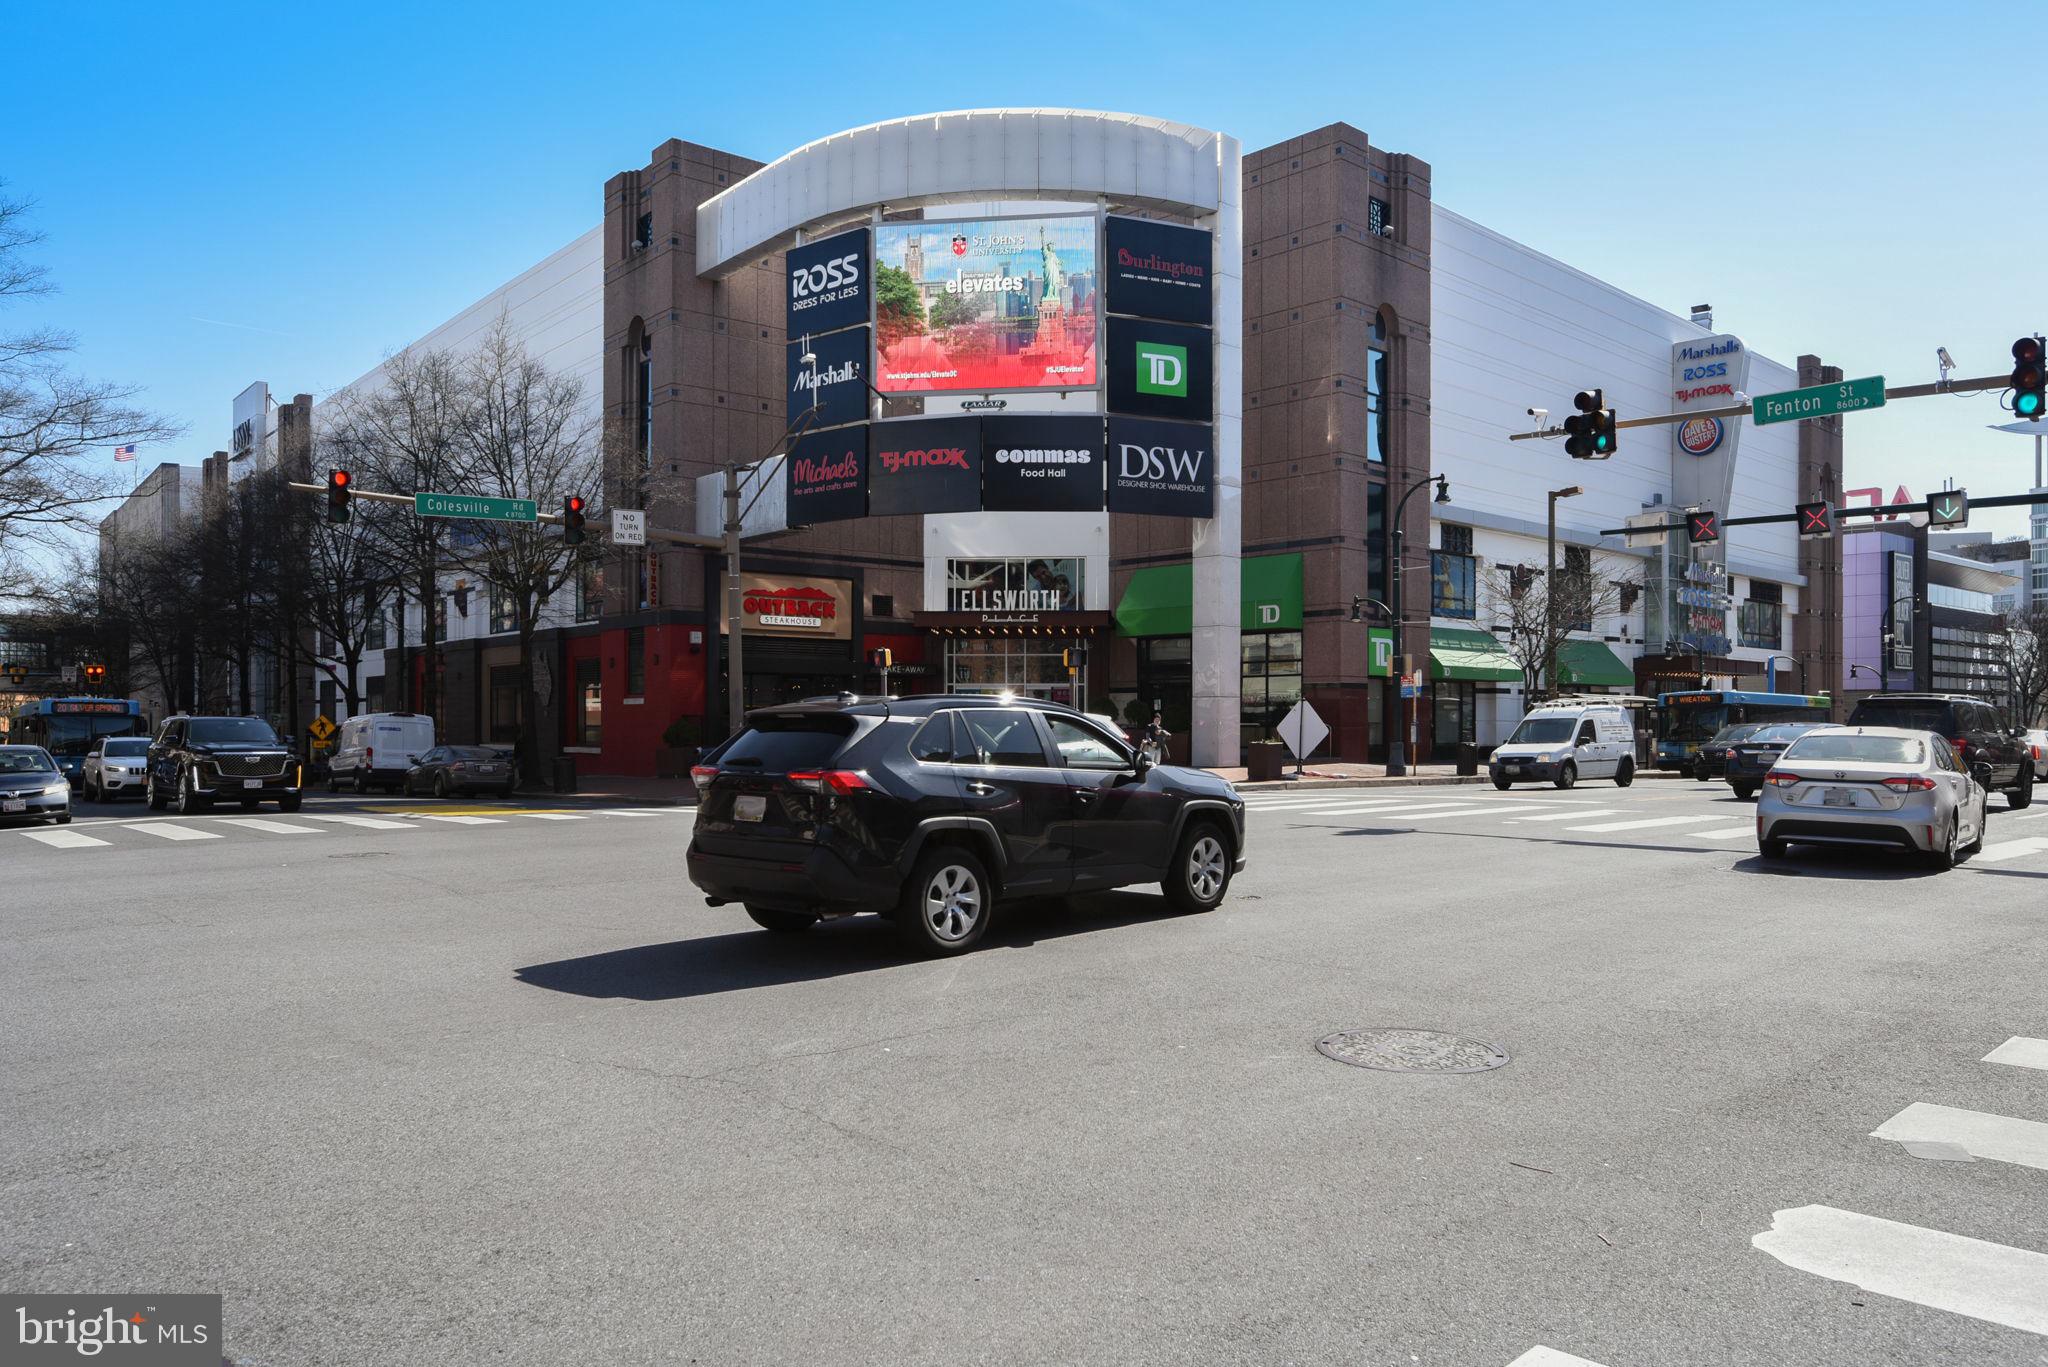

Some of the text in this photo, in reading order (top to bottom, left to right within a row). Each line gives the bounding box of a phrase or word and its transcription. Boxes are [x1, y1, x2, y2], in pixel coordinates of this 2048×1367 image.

[1117, 247, 1204, 278] Burlington
[793, 253, 859, 298] ROSS
[945, 268, 1024, 293] elevates
[793, 286, 859, 311] DRESS FOR LESS
[1676, 340, 1739, 362] Marshalls
[1141, 352, 1182, 386] TD
[1683, 362, 1728, 381] ROSS
[1766, 384, 1854, 417] Fenton St
[1836, 399, 1860, 409] 8600
[1684, 420, 1714, 439] DAVE &
[1685, 429, 1716, 447] BUSTER'S
[995, 449, 1091, 464] commas
[1118, 444, 1205, 482] DSW
[793, 450, 858, 485] Michaels
[1020, 469, 1066, 478] Food Hall
[814, 484, 826, 493] and
[1117, 480, 1206, 493] DESIGNER SHOE WAREHOUSE
[427, 498, 524, 514] Colesville Rd
[743, 597, 836, 619] OUTBACK
[961, 589, 1060, 611] ELLSWORTH
[764, 616, 818, 626] STEAKHOUSE
[982, 614, 1039, 622] PLACE
[1258, 605, 1280, 623] TD
[887, 665, 926, 673] AKE-AWAY
[1680, 695, 1711, 704] WHEATON
